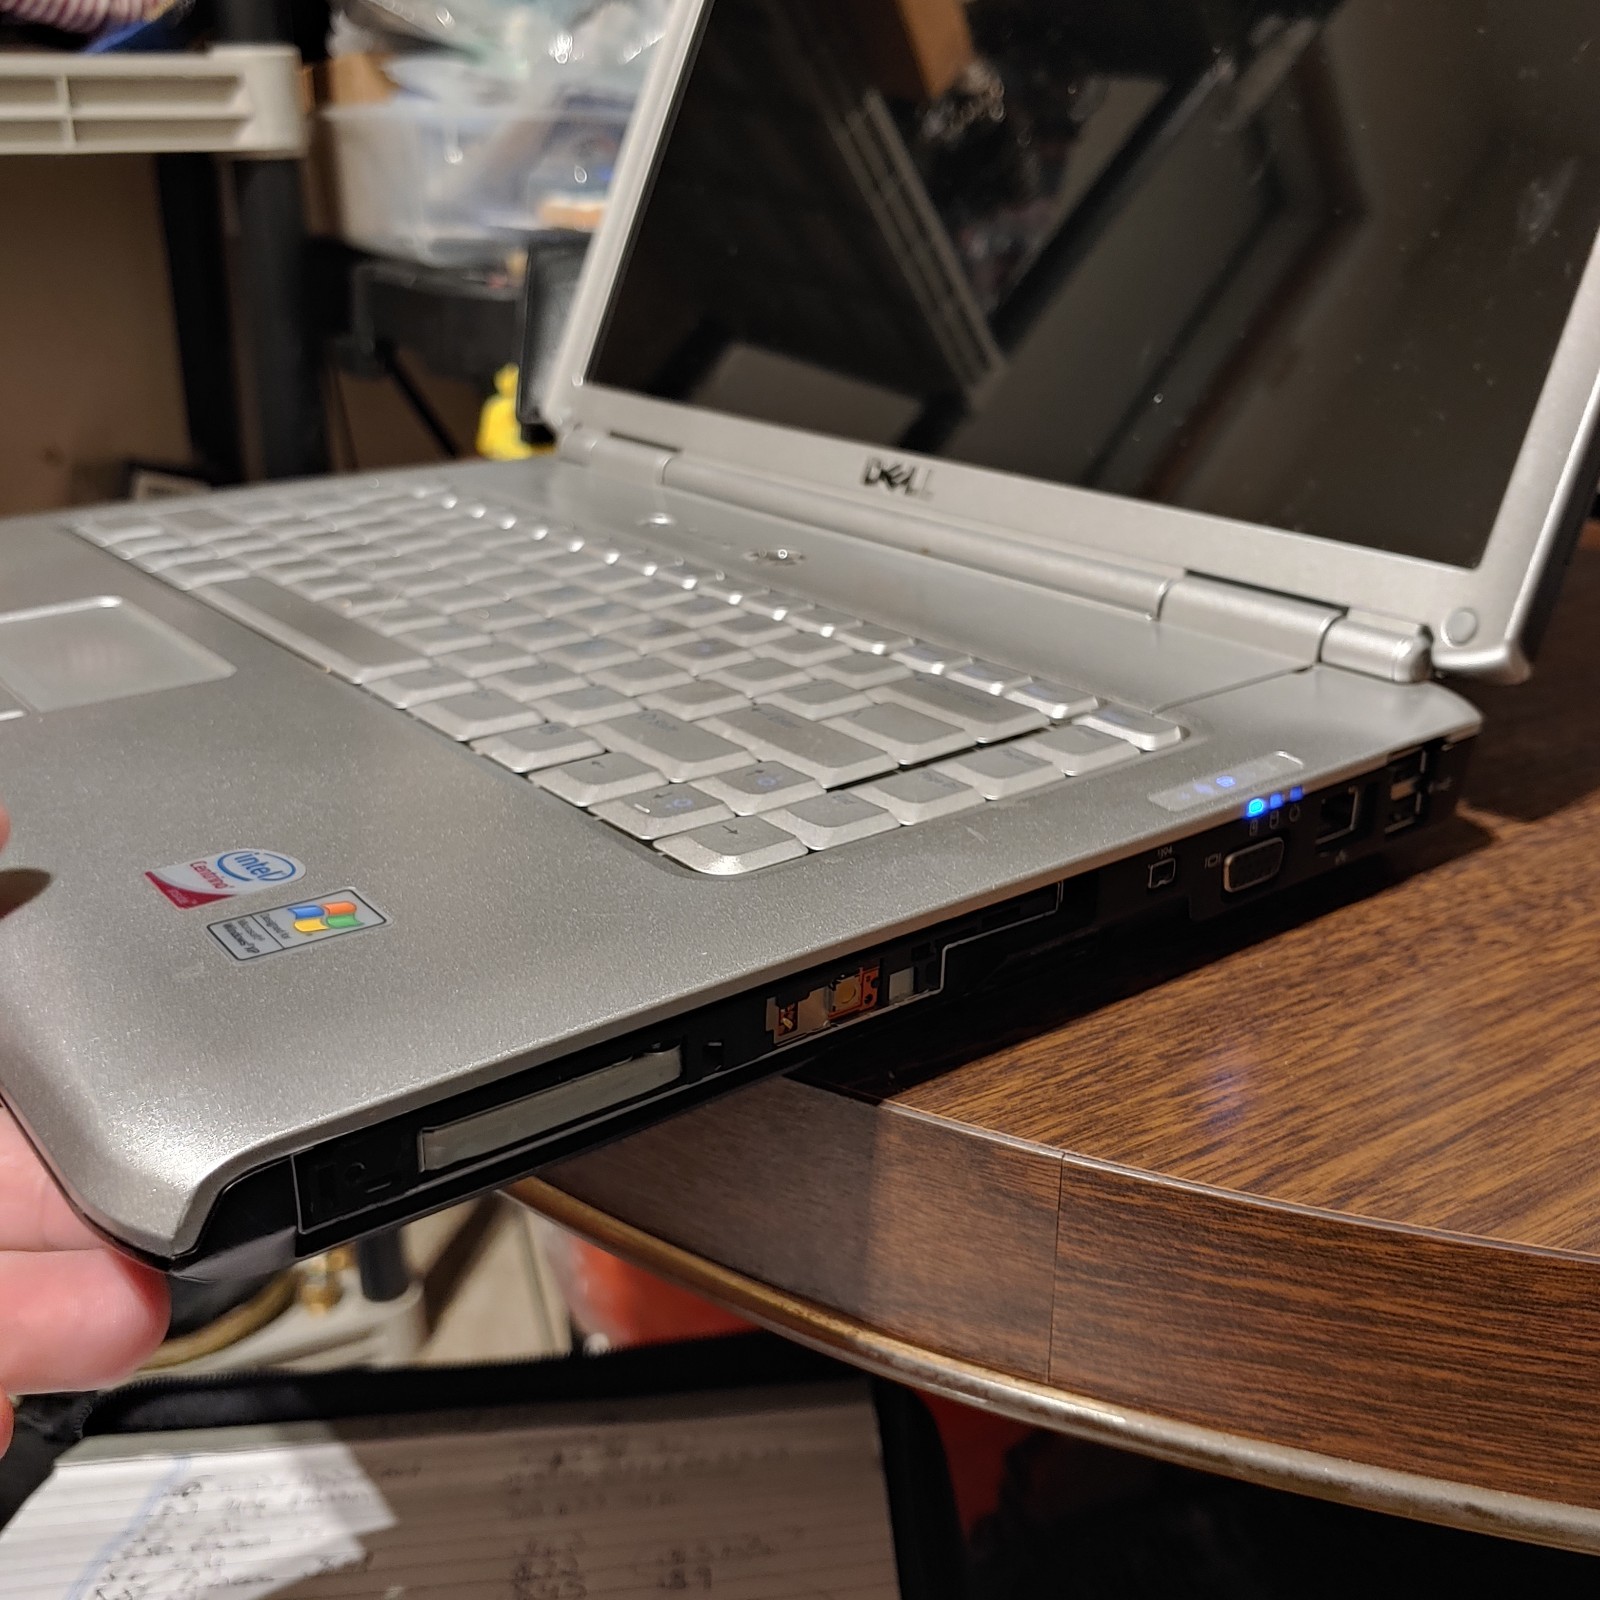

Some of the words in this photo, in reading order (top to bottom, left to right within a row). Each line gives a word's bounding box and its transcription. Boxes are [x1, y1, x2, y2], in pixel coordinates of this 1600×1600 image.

[863, 457, 933, 499] DELL
[189, 860, 229, 889] Centrino
[233, 851, 285, 879] intel
